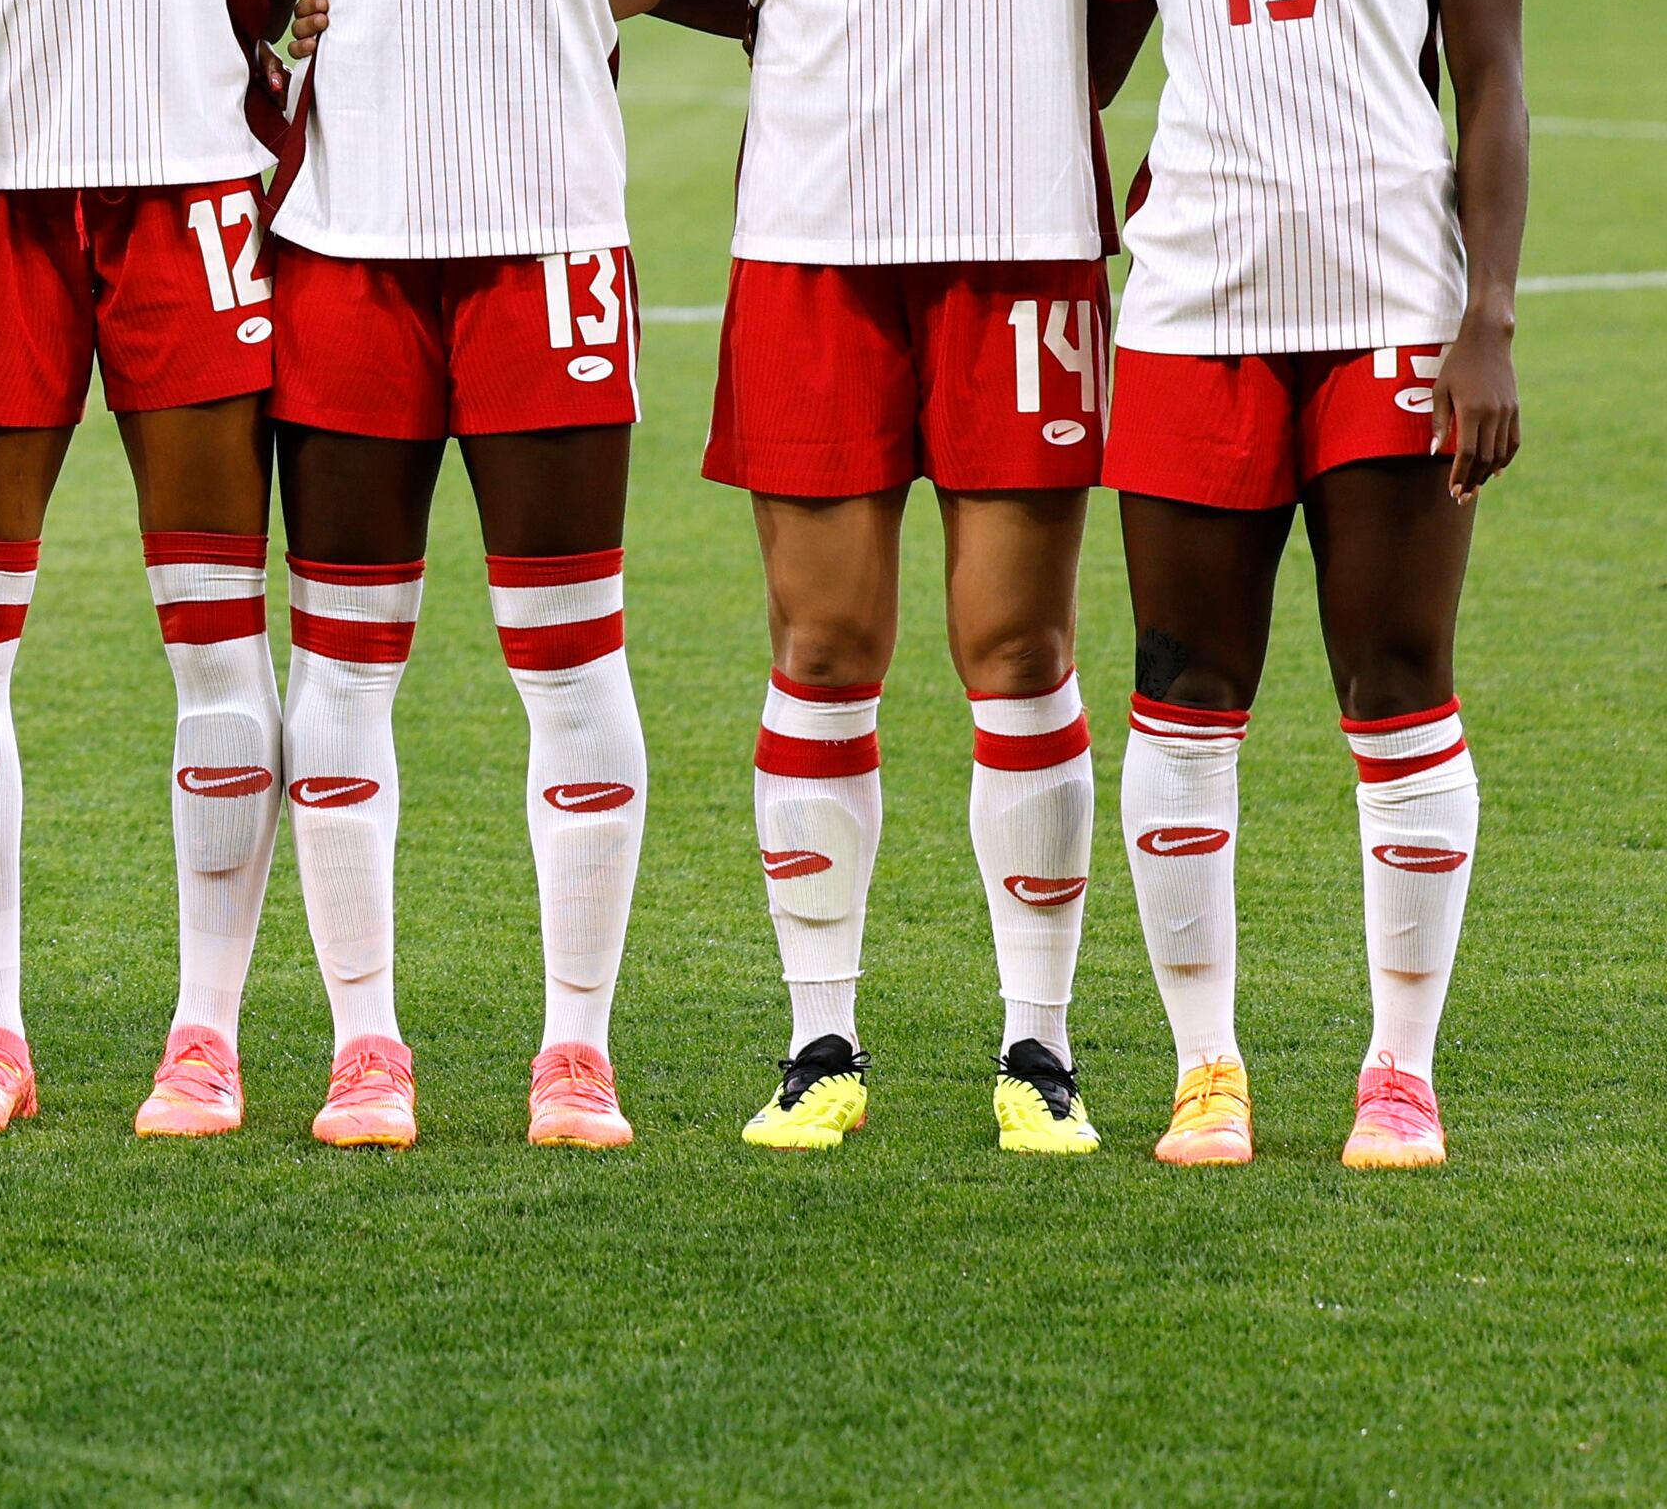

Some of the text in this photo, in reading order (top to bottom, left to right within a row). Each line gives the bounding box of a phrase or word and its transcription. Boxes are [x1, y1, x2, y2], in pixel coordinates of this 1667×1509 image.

[187, 190, 273, 312] 12
[536, 250, 620, 349] 13
[1007, 300, 1096, 413] 14
